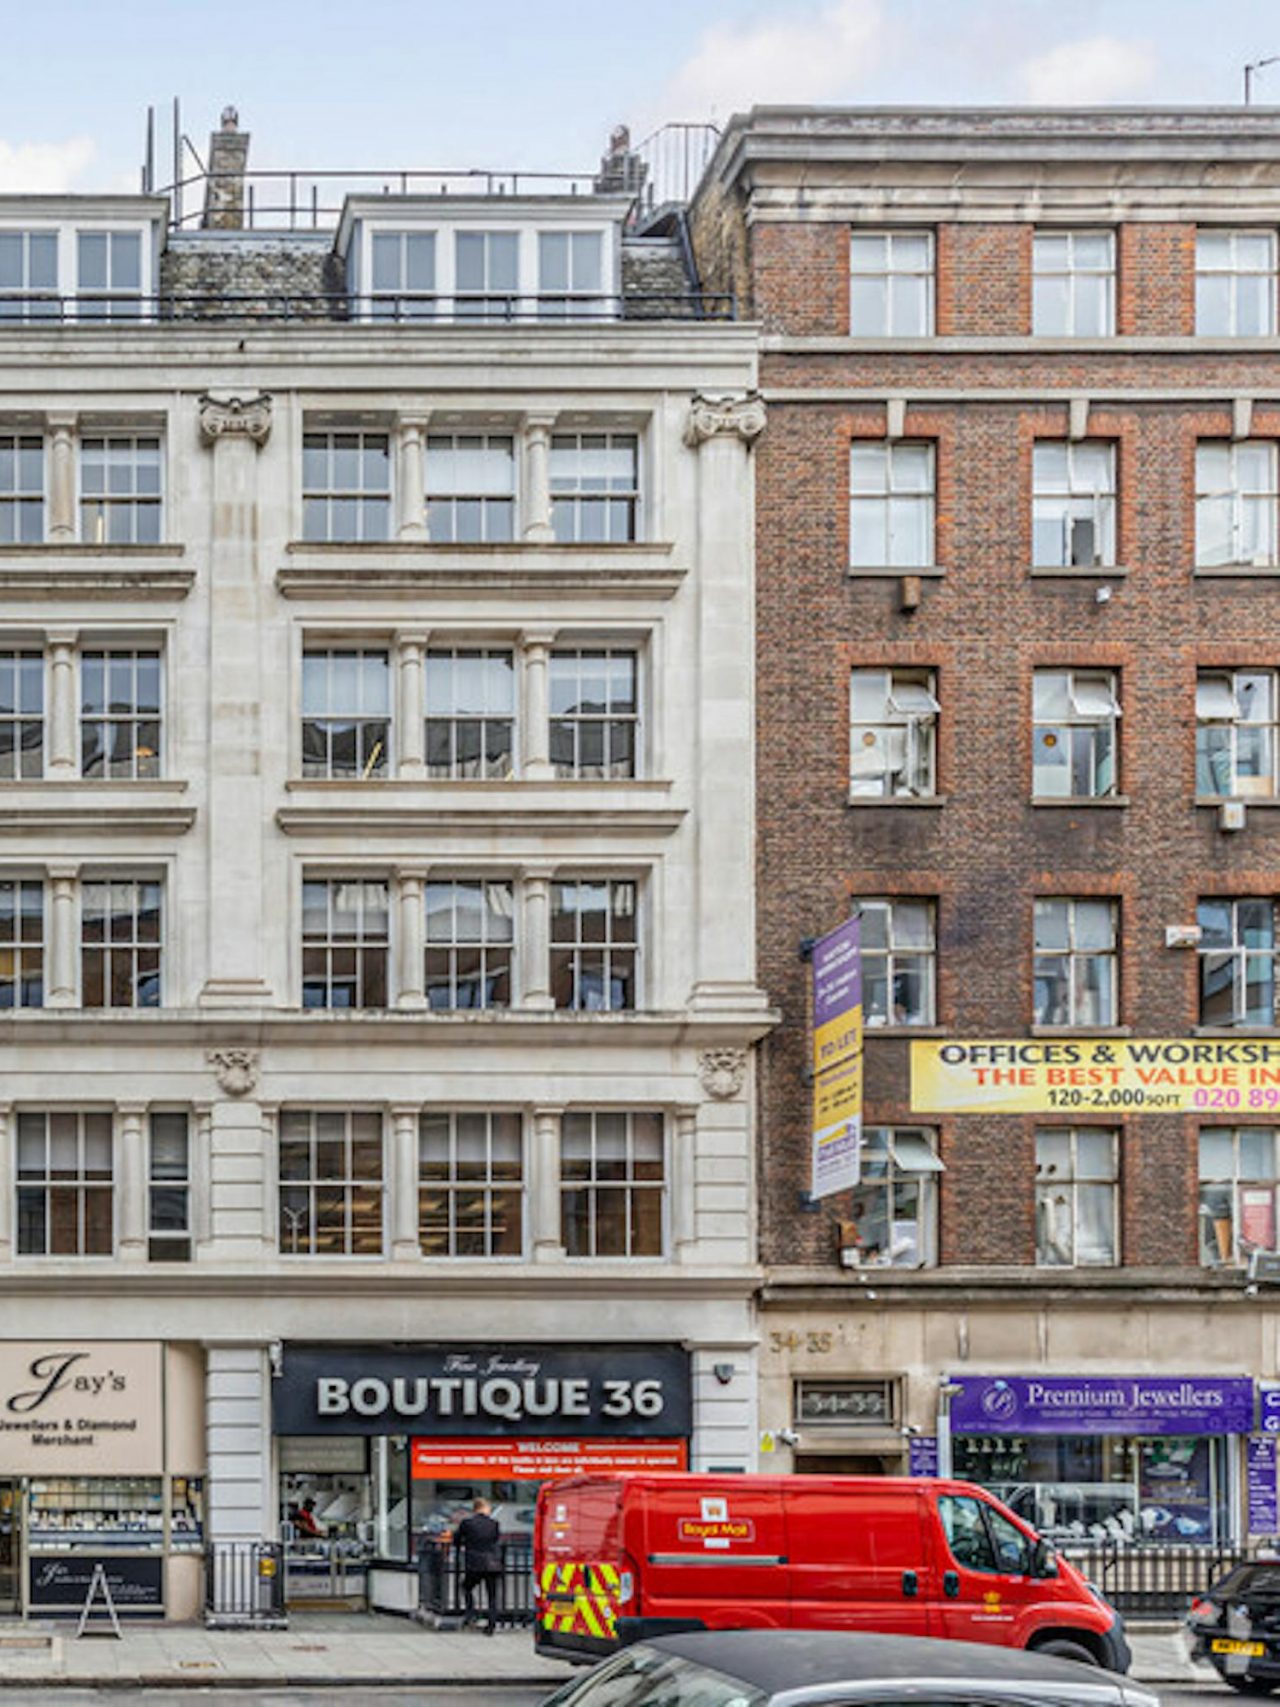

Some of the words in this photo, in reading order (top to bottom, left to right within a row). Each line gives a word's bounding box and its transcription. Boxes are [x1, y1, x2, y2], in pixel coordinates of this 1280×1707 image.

[939, 1045, 1081, 1064] OFFICES
[1091, 1045, 1115, 1063] &
[972, 1068, 1036, 1086] THE
[1047, 1068, 1124, 1086] BEST
[1135, 1068, 1238, 1086] VALUE
[1250, 1068, 1280, 1085] IN
[1048, 1089, 1144, 1107] 120-2,000
[1194, 1088, 1240, 1107] 020
[1248, 1088, 1280, 1108] 89
[7, 1353, 125, 1413] Jay's
[317, 1378, 590, 1419] BOUTIQUE
[601, 1380, 663, 1416] 36
[1027, 1384, 1124, 1406] Premium
[1130, 1384, 1223, 1411] Jewellers
[64, 1420, 73, 1431] &
[77, 1419, 136, 1431] Diamond
[32, 1434, 93, 1445] Merchant
[684, 1523, 718, 1537] Royal
[721, 1523, 747, 1536] Mail
